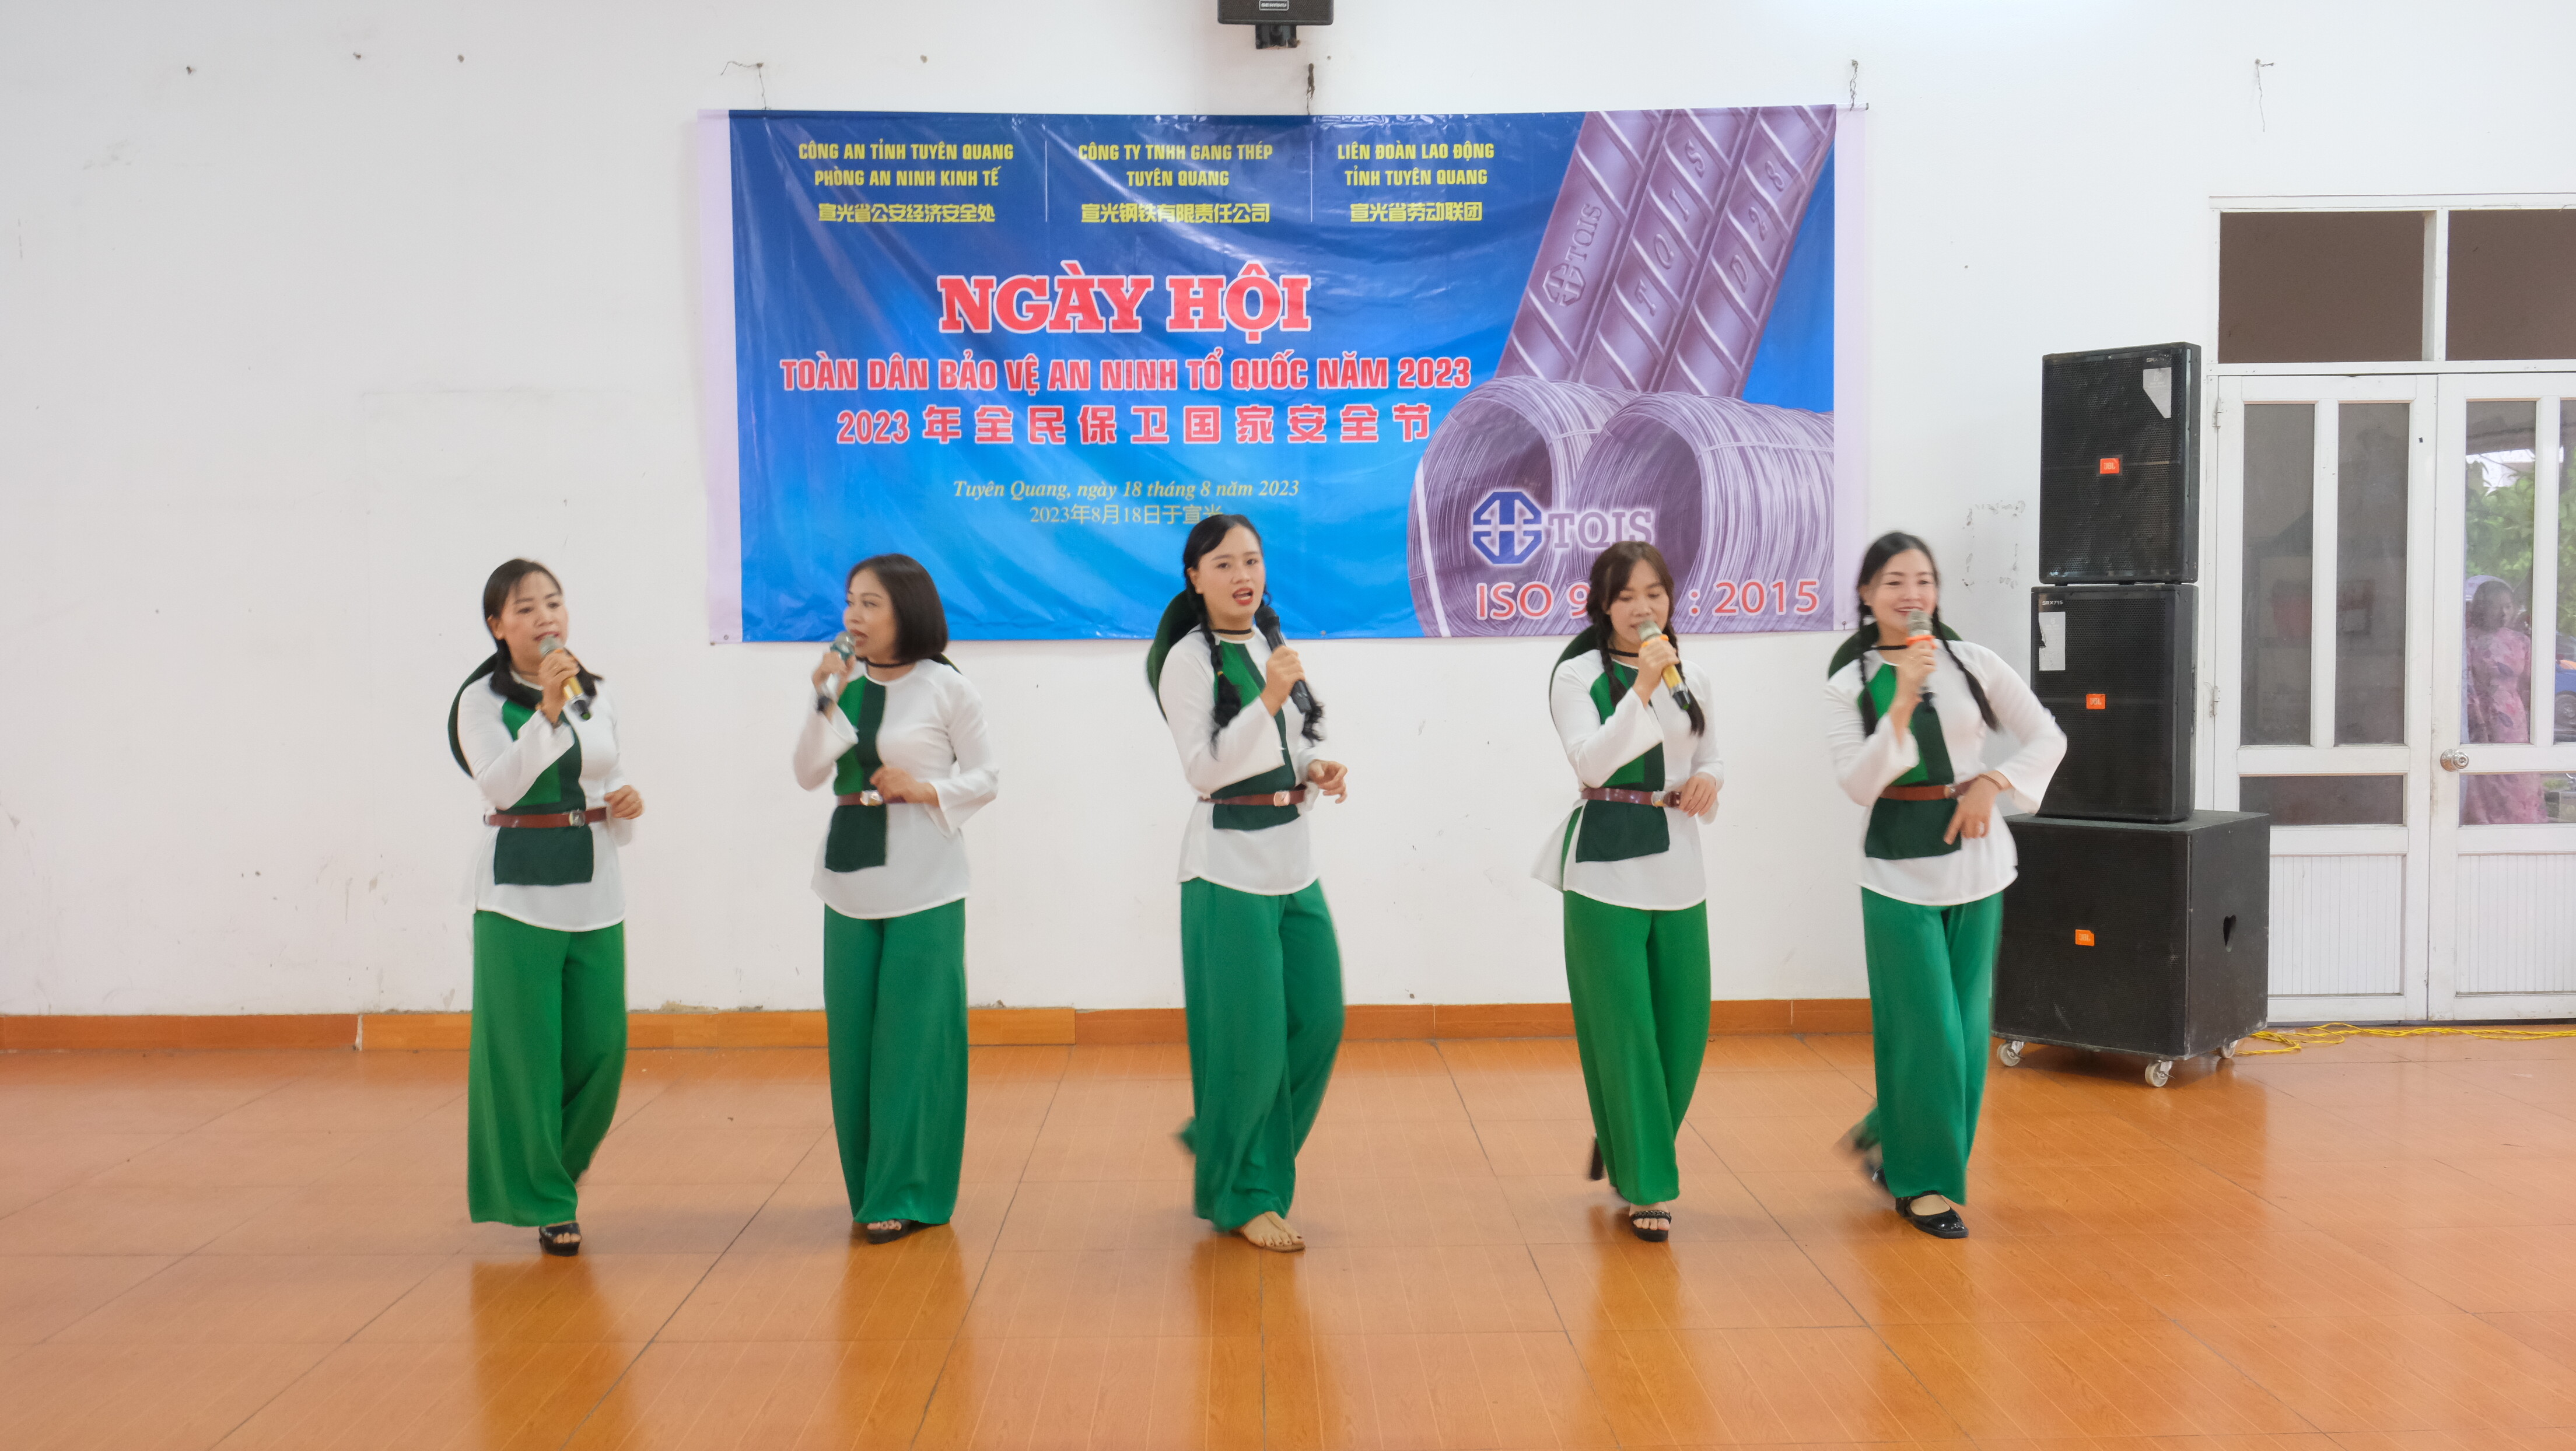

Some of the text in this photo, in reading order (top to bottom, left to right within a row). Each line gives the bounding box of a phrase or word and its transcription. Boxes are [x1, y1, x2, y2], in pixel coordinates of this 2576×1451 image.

[799, 138, 1014, 160] CÔNG AN TỈNH TUYÊN QUANG
[1079, 140, 1273, 160] CÔNG TY TNHH GANG THÉP
[1338, 139, 1494, 160] LIÊN ĐOÀN LAO ĐỘNG
[814, 165, 1001, 187] PHÒNG AN NINH KINH TẾ
[1126, 167, 1229, 187] TUYÊN QUANG
[1345, 164, 1488, 186] TỈNH TUYÊN QUANG
[818, 203, 995, 223] 宣光省公安经济安全处
[1082, 202, 1270, 223] 宣光钢铁有限责任公司
[1350, 201, 1483, 222] 宣光省劳动联团
[938, 261, 1311, 342] NGÀY HỘI
[780, 346, 1472, 396] TOÀN DÂN BẢO VỆ AN NINH TỔ QUỐC NĂM 2023
[837, 410, 911, 444] 2023
[2104, 462, 2116, 470] JBL
[953, 479, 1300, 500] Tuyên Quang, ngày 18 tháng 8 năm 2023
[1548, 510, 1653, 548] TQIS
[1478, 582, 1554, 619] ISO
[1713, 579, 1819, 615] 2015
